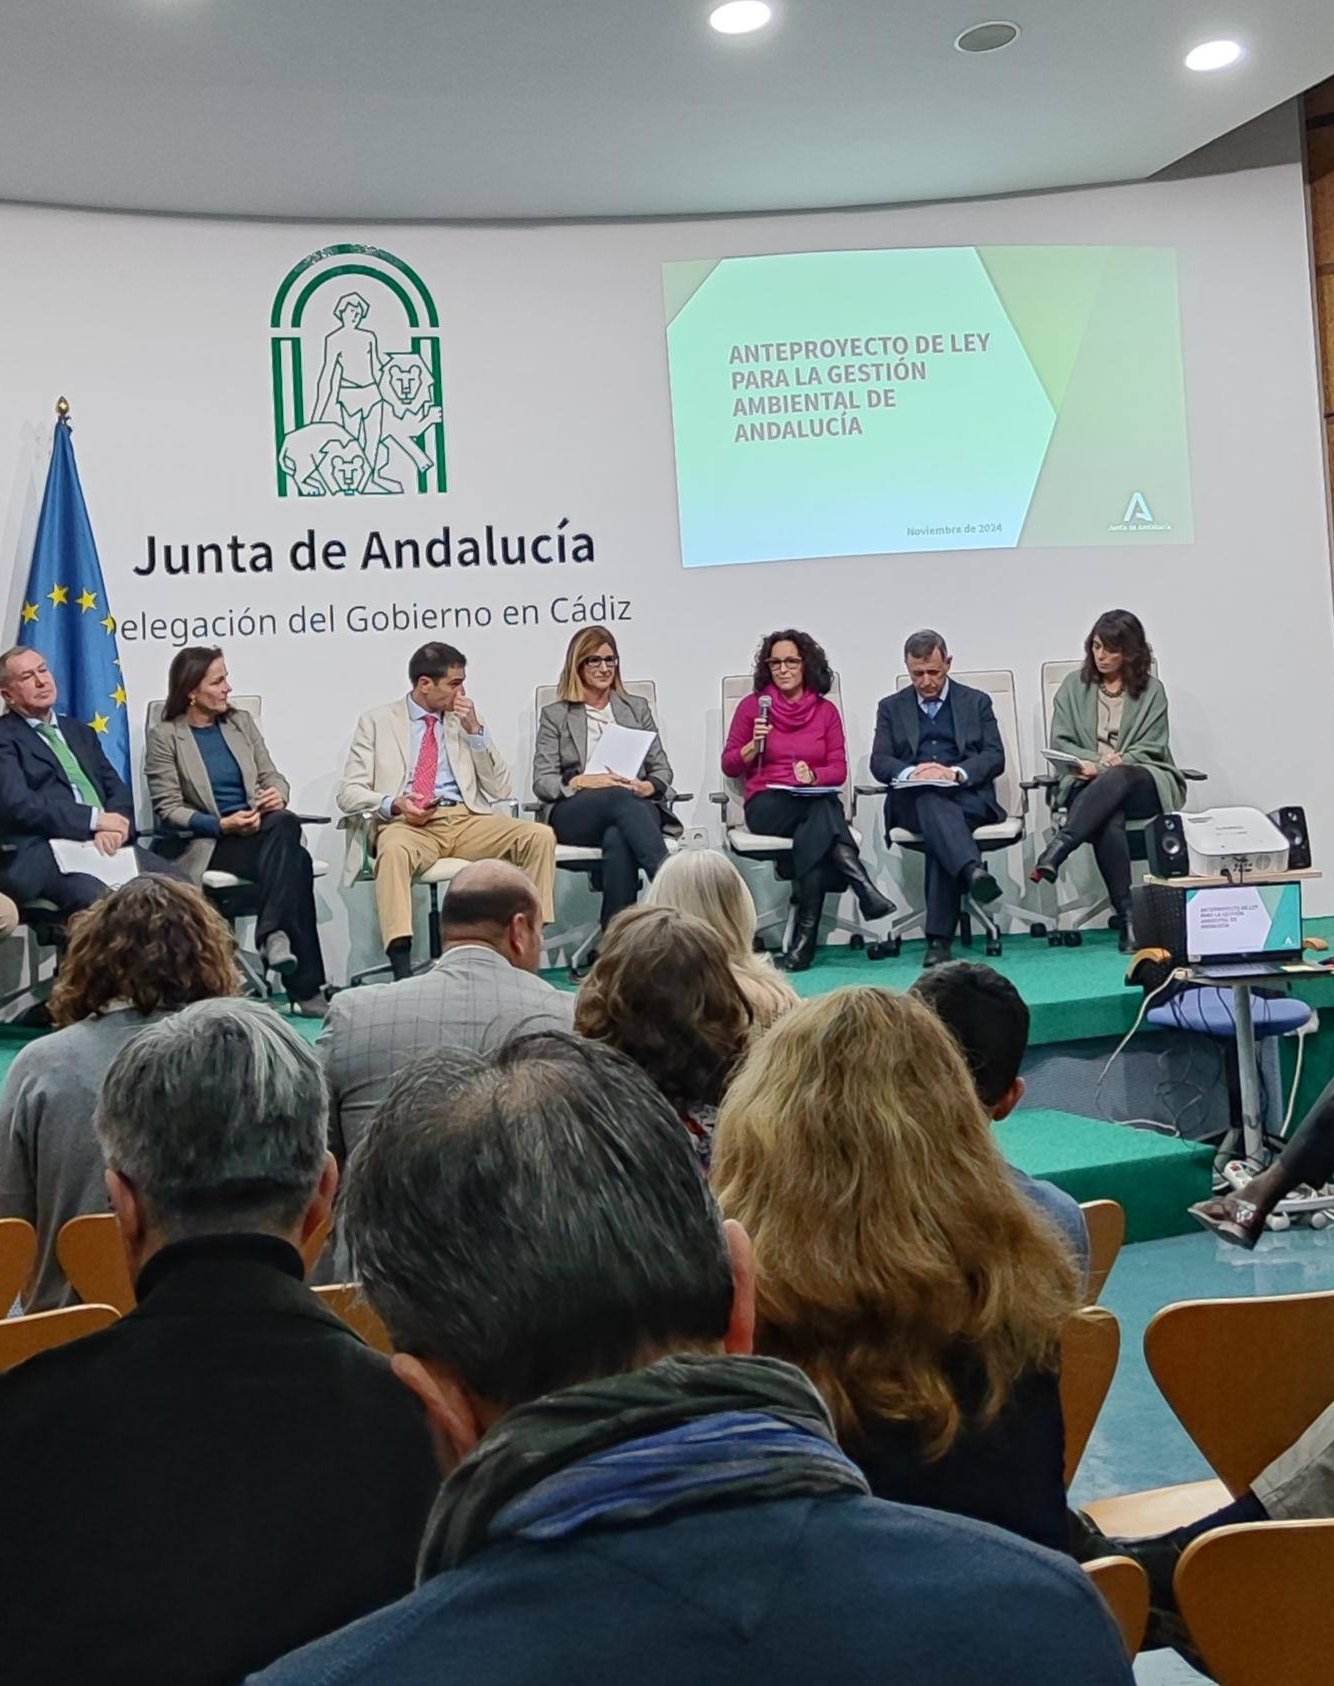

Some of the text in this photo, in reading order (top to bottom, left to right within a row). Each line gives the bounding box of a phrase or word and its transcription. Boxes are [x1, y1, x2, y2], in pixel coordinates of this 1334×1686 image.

[729, 331, 991, 365] ANTEPROYECTO DE LEY
[731, 357, 927, 391] PARA LA GESTIÓN
[732, 388, 897, 417] AMBIENTAL DE
[734, 411, 863, 443] ANDALUCÍA
[133, 518, 596, 576] Junta de Andalucía
[907, 523, 1003, 537] Noviembre de 2024
[288, 604, 335, 635] del
[346, 600, 492, 633] Gobierno
[503, 603, 540, 625] en
[550, 594, 633, 624] Cádiz
